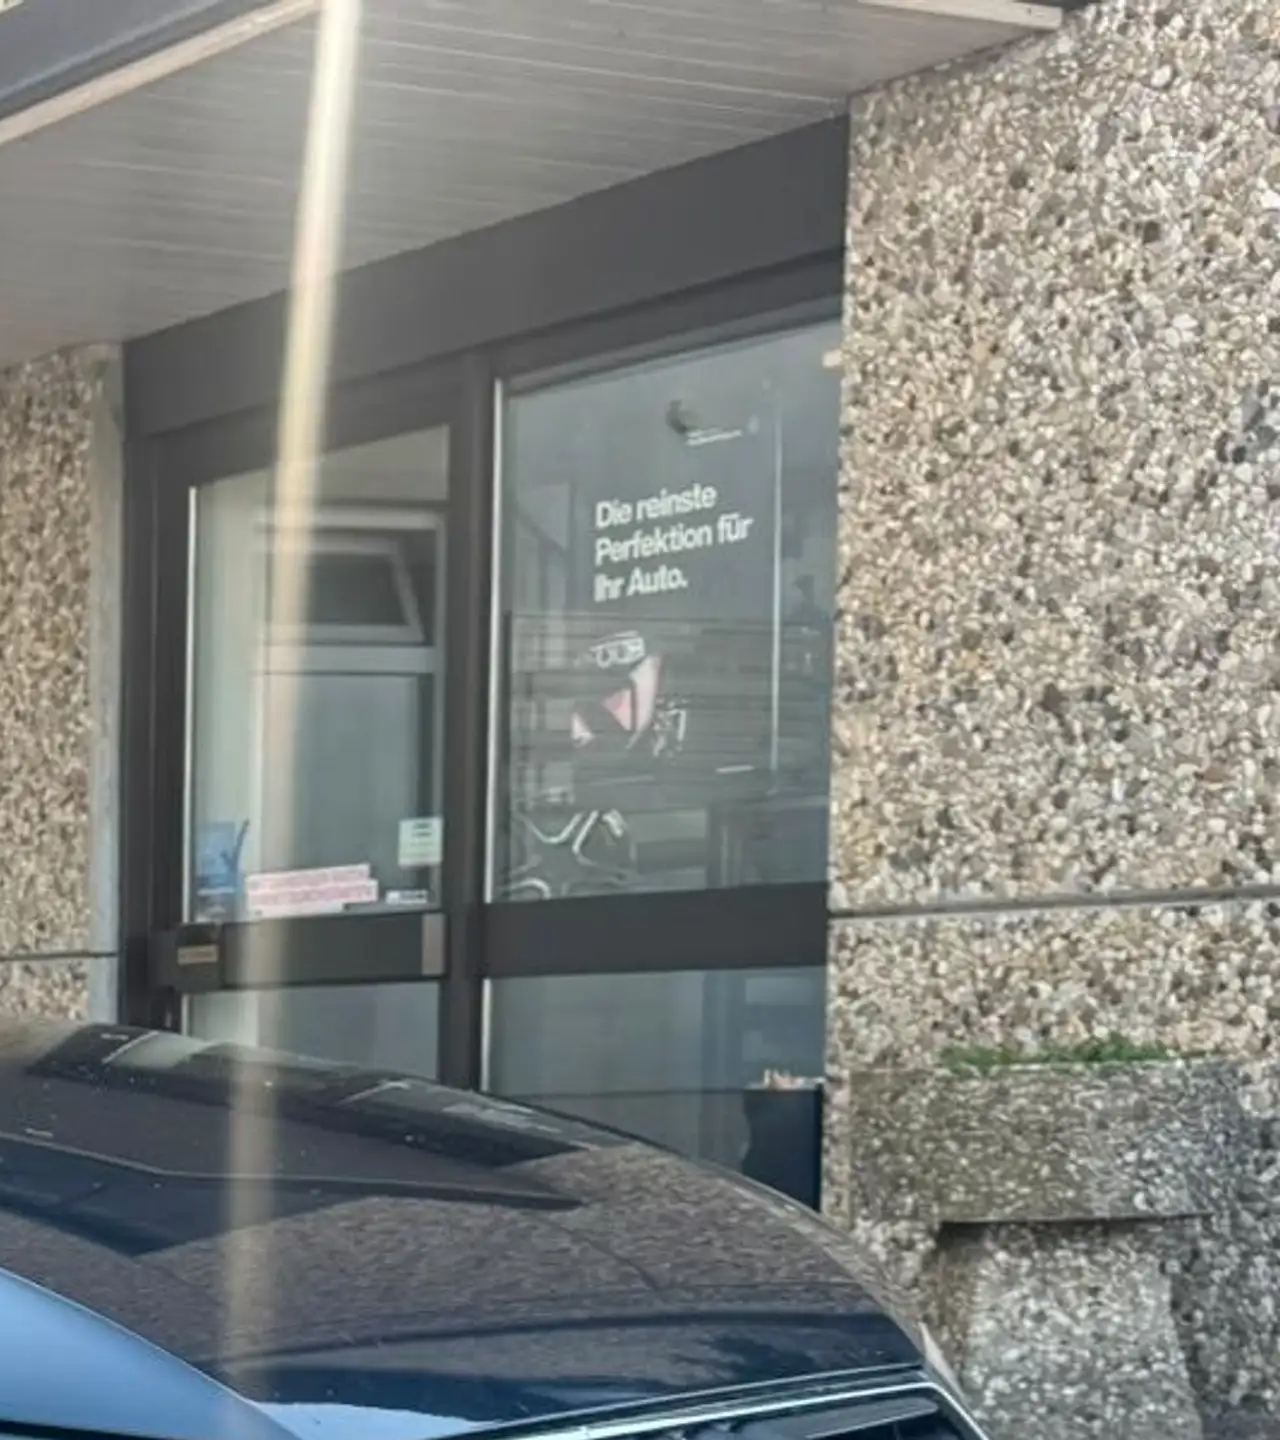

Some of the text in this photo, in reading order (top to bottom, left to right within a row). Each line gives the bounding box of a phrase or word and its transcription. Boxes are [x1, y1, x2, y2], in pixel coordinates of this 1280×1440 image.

[595, 483, 718, 529] Die reinste
[594, 512, 755, 566] Perfektion für
[594, 564, 689, 602] Ihr Auto.
